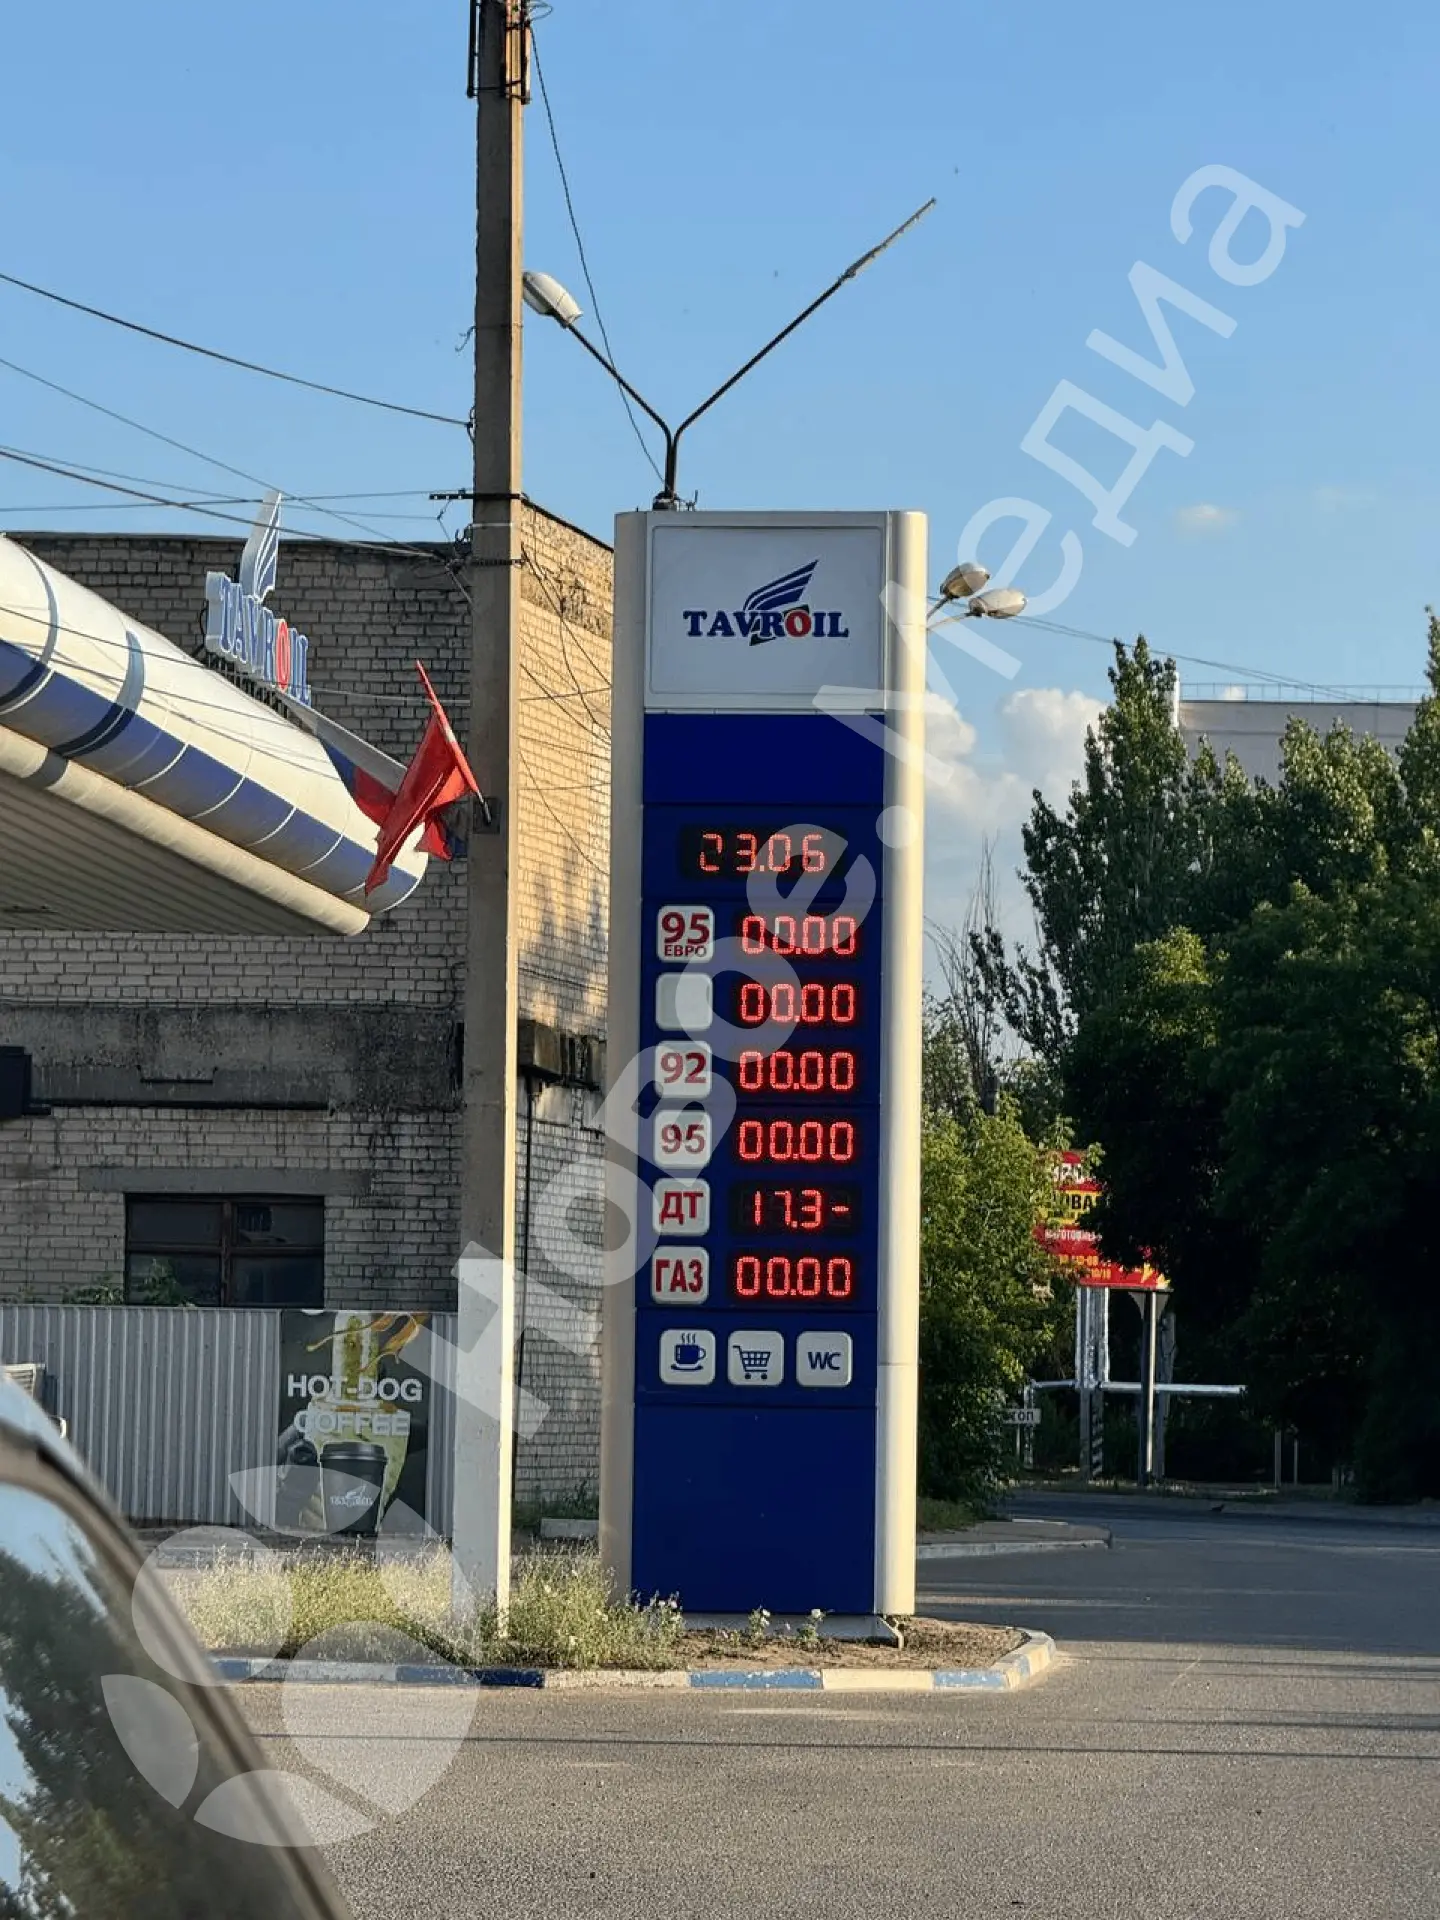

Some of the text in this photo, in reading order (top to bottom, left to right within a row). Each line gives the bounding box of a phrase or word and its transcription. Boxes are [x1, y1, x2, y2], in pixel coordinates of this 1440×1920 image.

[206, 571, 311, 708] TAVROIL
[682, 610, 849, 638] TAVROIL
[661, 911, 710, 945] 95
[742, 916, 855, 955] 00.00
[664, 944, 707, 957] ЕВРО
[741, 983, 854, 1022] 00.00
[660, 1052, 706, 1083] 92
[739, 1051, 853, 1089] 00.00
[660, 1124, 705, 1153] 95
[739, 1121, 853, 1160] 00.00
[659, 1190, 704, 1225] ДТ
[655, 1258, 704, 1293] ГАЗ
[737, 1257, 850, 1296] 00.00
[807, 1351, 841, 1370] WC
[287, 1373, 422, 1401] HOT-DOG
[294, 1411, 410, 1436] COFFEE
